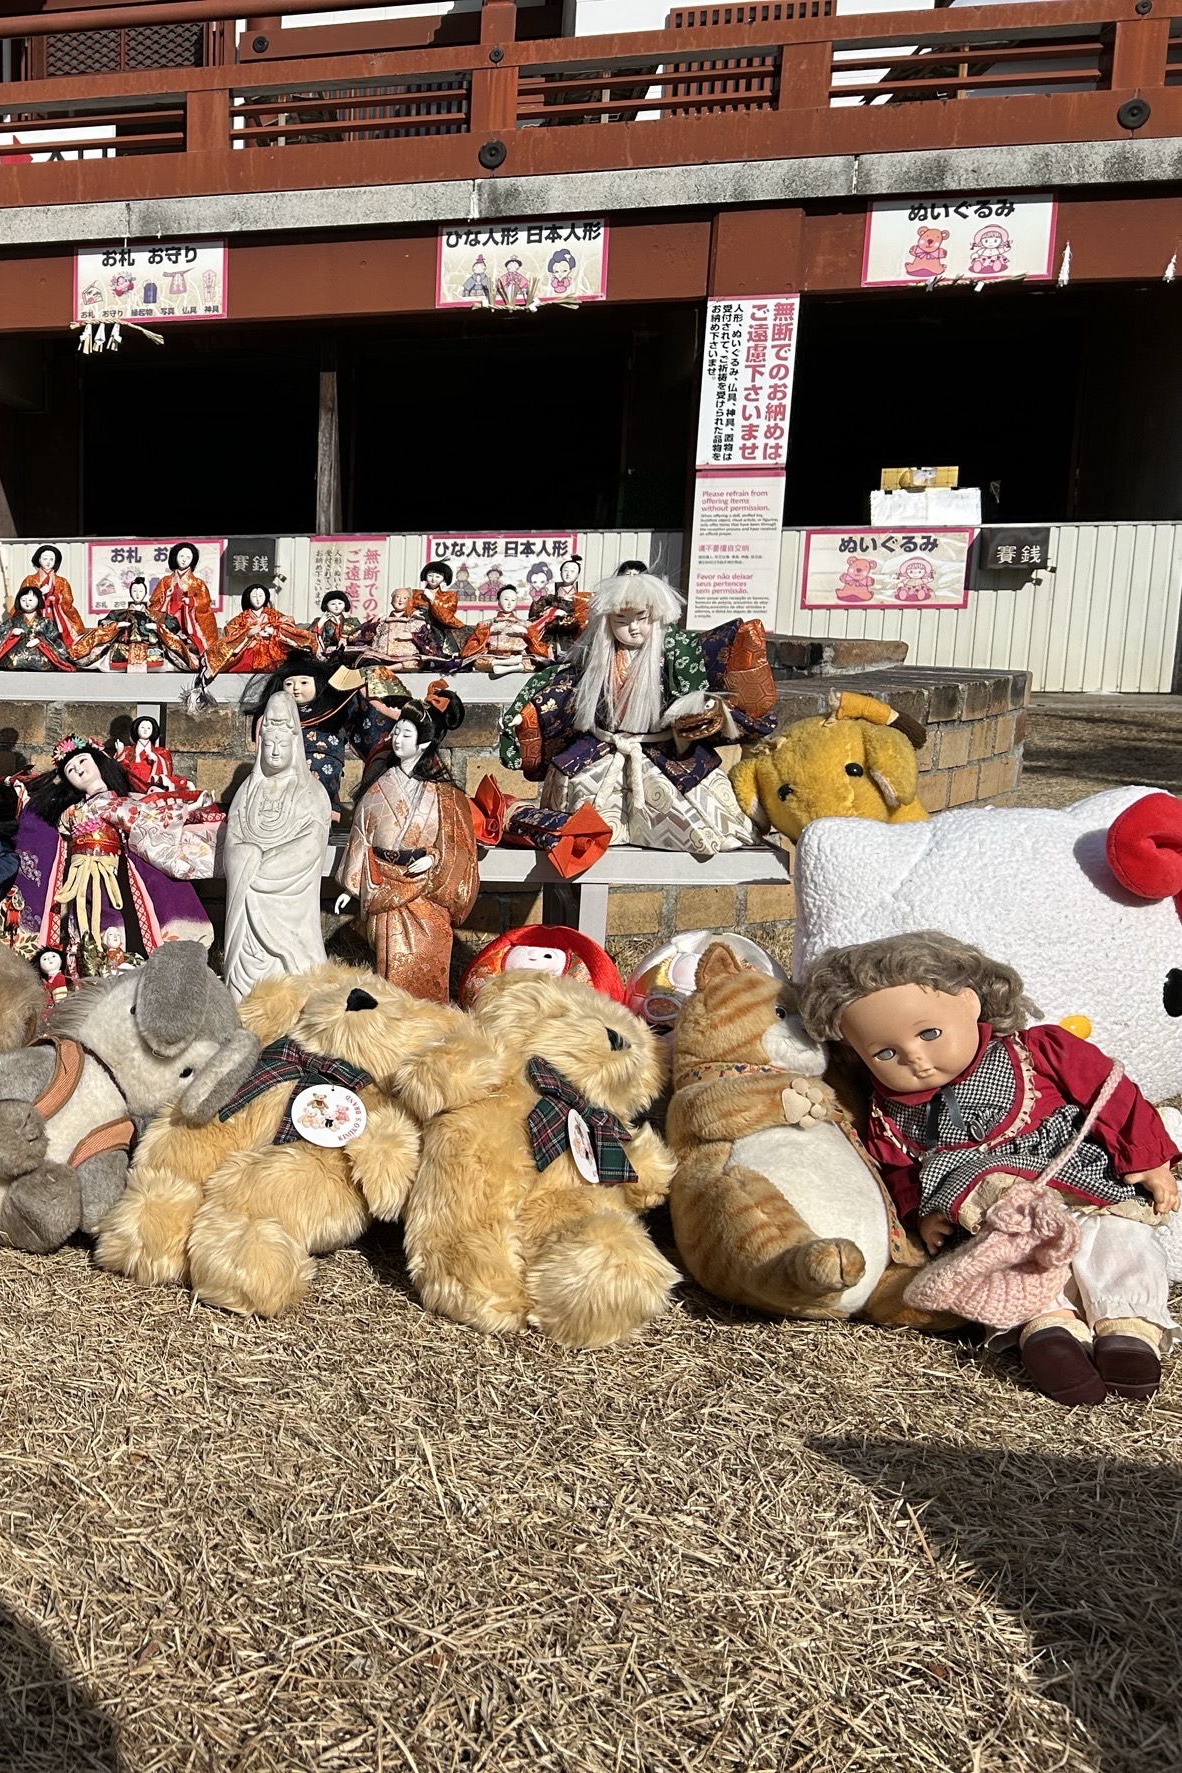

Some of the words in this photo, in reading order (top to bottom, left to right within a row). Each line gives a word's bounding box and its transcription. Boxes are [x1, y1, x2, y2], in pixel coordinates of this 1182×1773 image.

[908, 198, 1016, 222] ぬいぐるみ
[446, 227, 519, 248] ひな人形
[526, 221, 602, 244] 日本人形
[101, 248, 136, 267] お札
[148, 245, 198, 265] お守り
[160, 307, 175, 316] 写真
[182, 306, 197, 314] 仏具
[204, 306, 220, 314] 神具
[707, 304, 722, 381] お納め下さいませ。
[738, 303, 770, 461] ご遠慮下さいませ
[762, 302, 795, 461] 無断でのお納めは
[434, 541, 498, 558] ひな人形
[504, 540, 569, 558] 日本人形
[838, 535, 939, 553] ぬいぐるみ
[996, 544, 1041, 564] 賽銭
[110, 547, 142, 564] お札
[232, 555, 269, 572] 賽銭
[345, 1095, 362, 1115] BRAND
